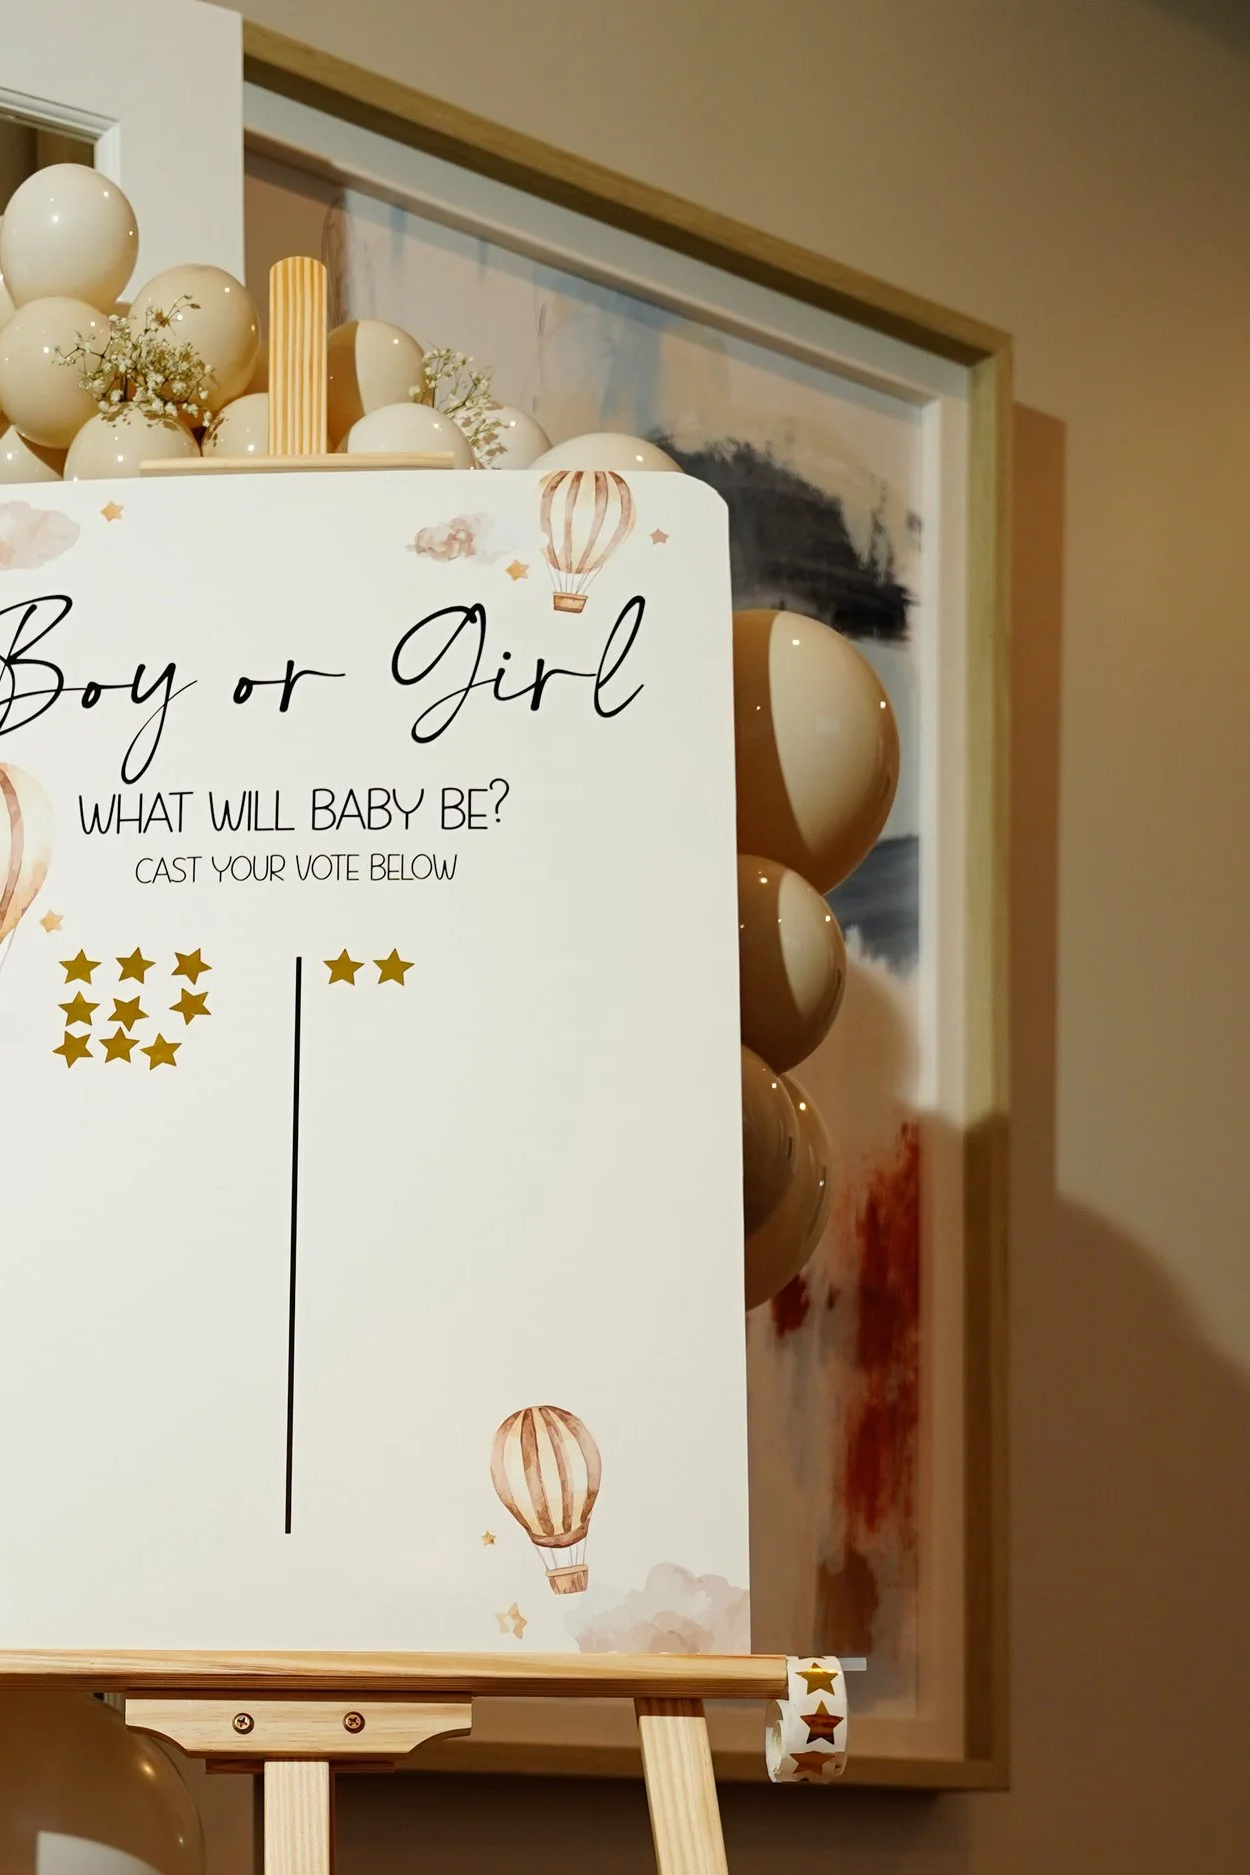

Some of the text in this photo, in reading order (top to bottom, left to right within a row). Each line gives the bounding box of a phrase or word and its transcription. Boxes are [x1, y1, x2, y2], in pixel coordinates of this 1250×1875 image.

[233, 660, 346, 713] or
[391, 595, 645, 744] Girl
[78, 777, 510, 835] WHAT WILL BABY BE?
[135, 852, 458, 884] CAST YOUR VOTE BELOW
